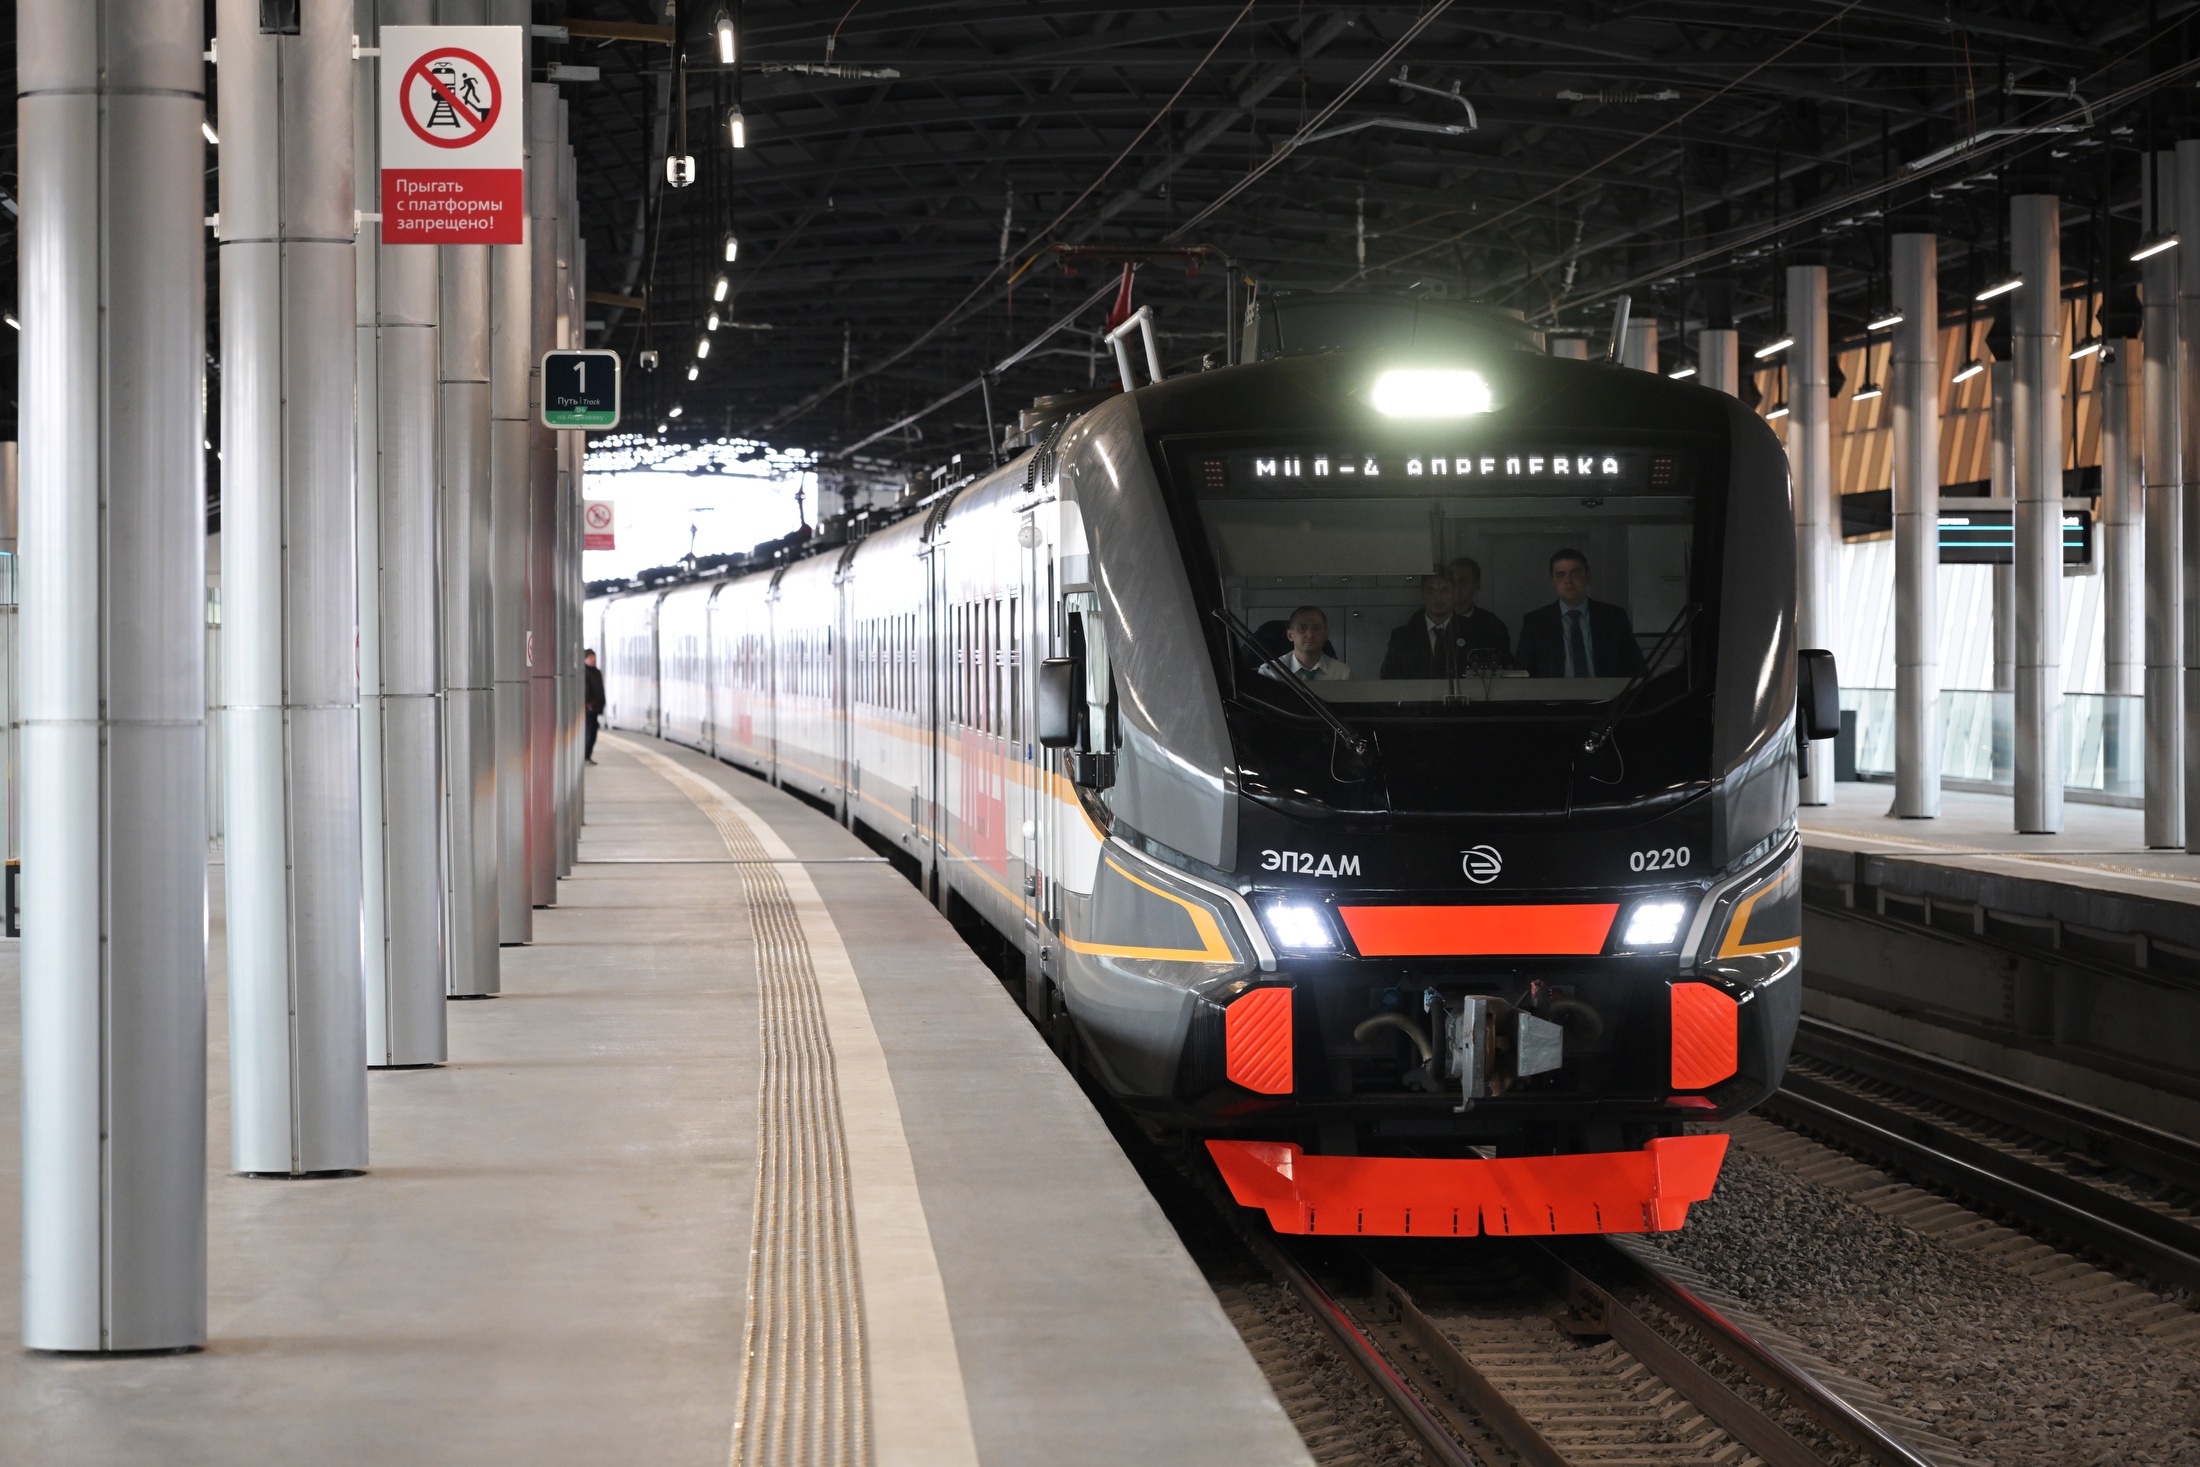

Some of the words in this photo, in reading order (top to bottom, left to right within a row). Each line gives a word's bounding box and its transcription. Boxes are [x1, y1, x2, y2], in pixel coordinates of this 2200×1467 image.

[396, 179, 464, 196] Прыгать
[397, 200, 405, 211] с
[408, 197, 503, 214] платформы
[397, 216, 494, 233] запрещено!
[573, 361, 586, 393] 1
[557, 396, 578, 406] Путь
[1261, 849, 1361, 878] ЭП2ДМ
[1629, 846, 1691, 872] 0220
